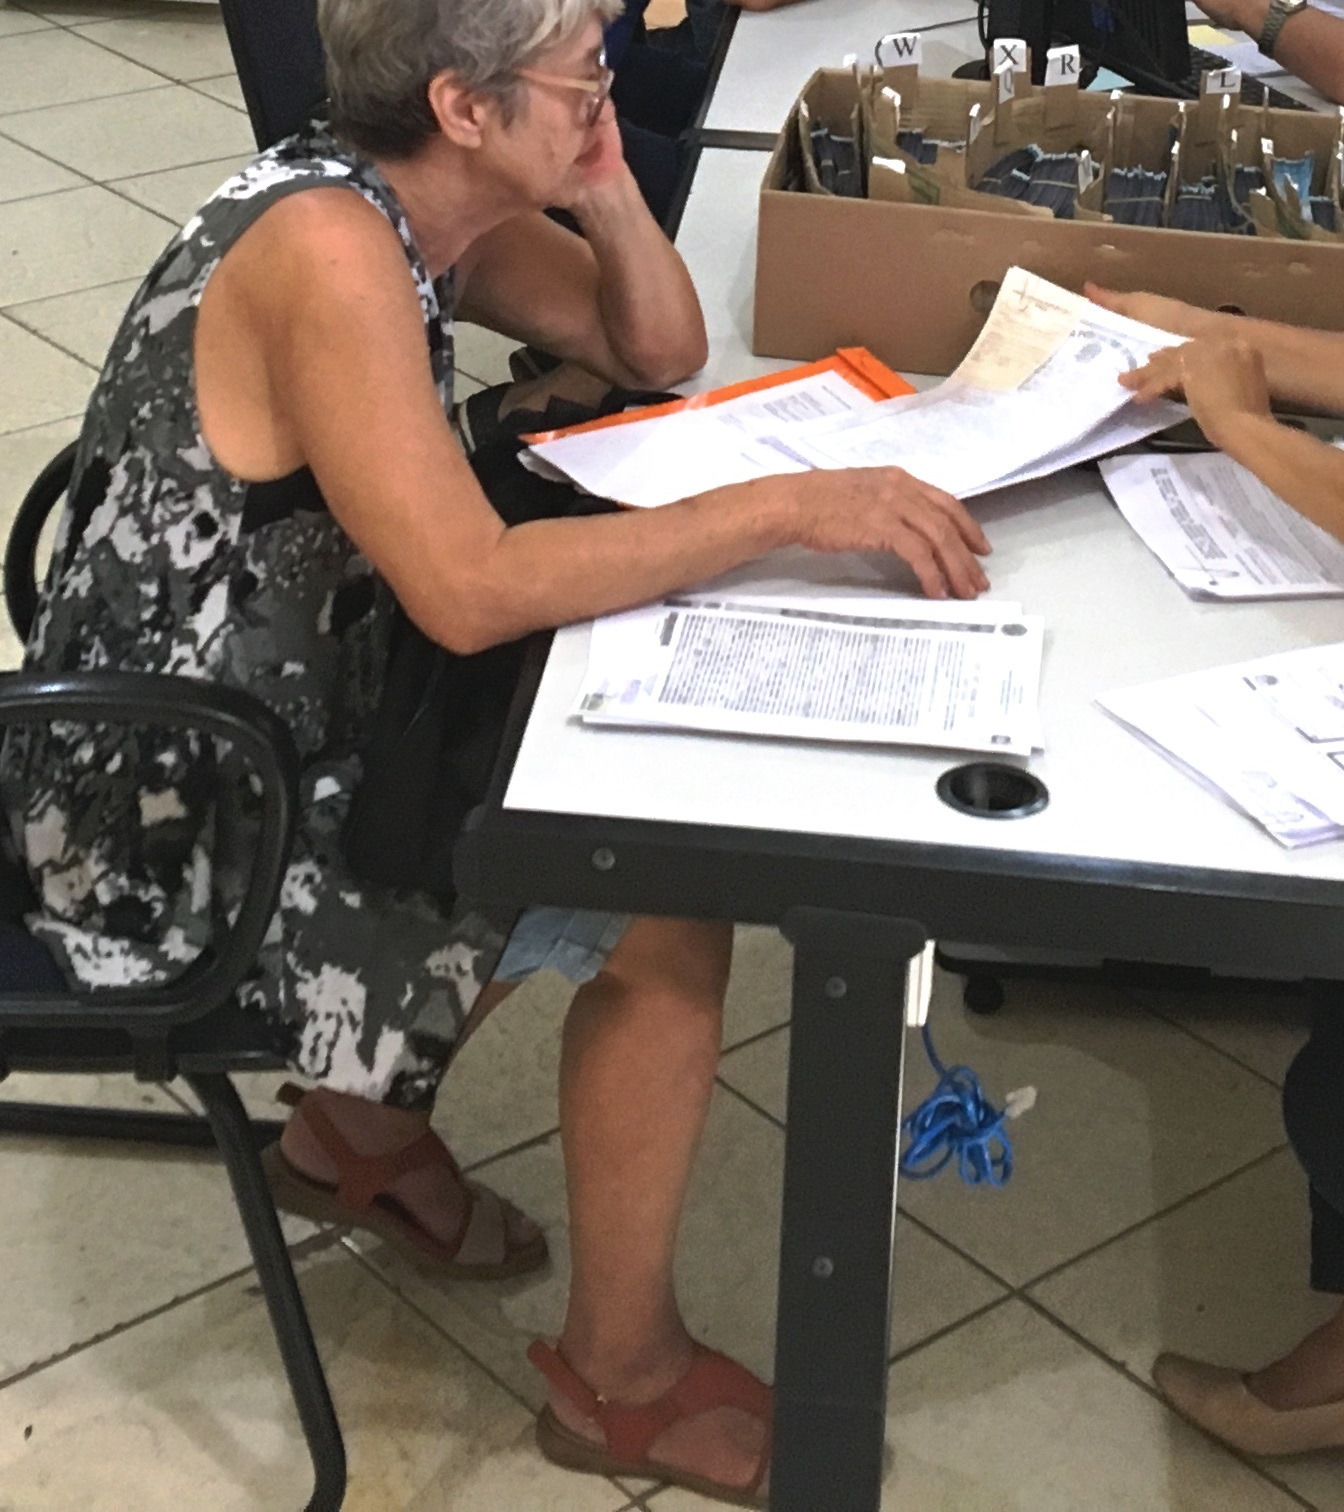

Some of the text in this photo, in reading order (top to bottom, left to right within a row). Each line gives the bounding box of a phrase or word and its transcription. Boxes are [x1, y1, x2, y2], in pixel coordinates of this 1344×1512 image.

[892, 36, 918, 59] W
[998, 44, 1019, 65] X
[1060, 53, 1076, 76] R
[1219, 71, 1236, 88] L
